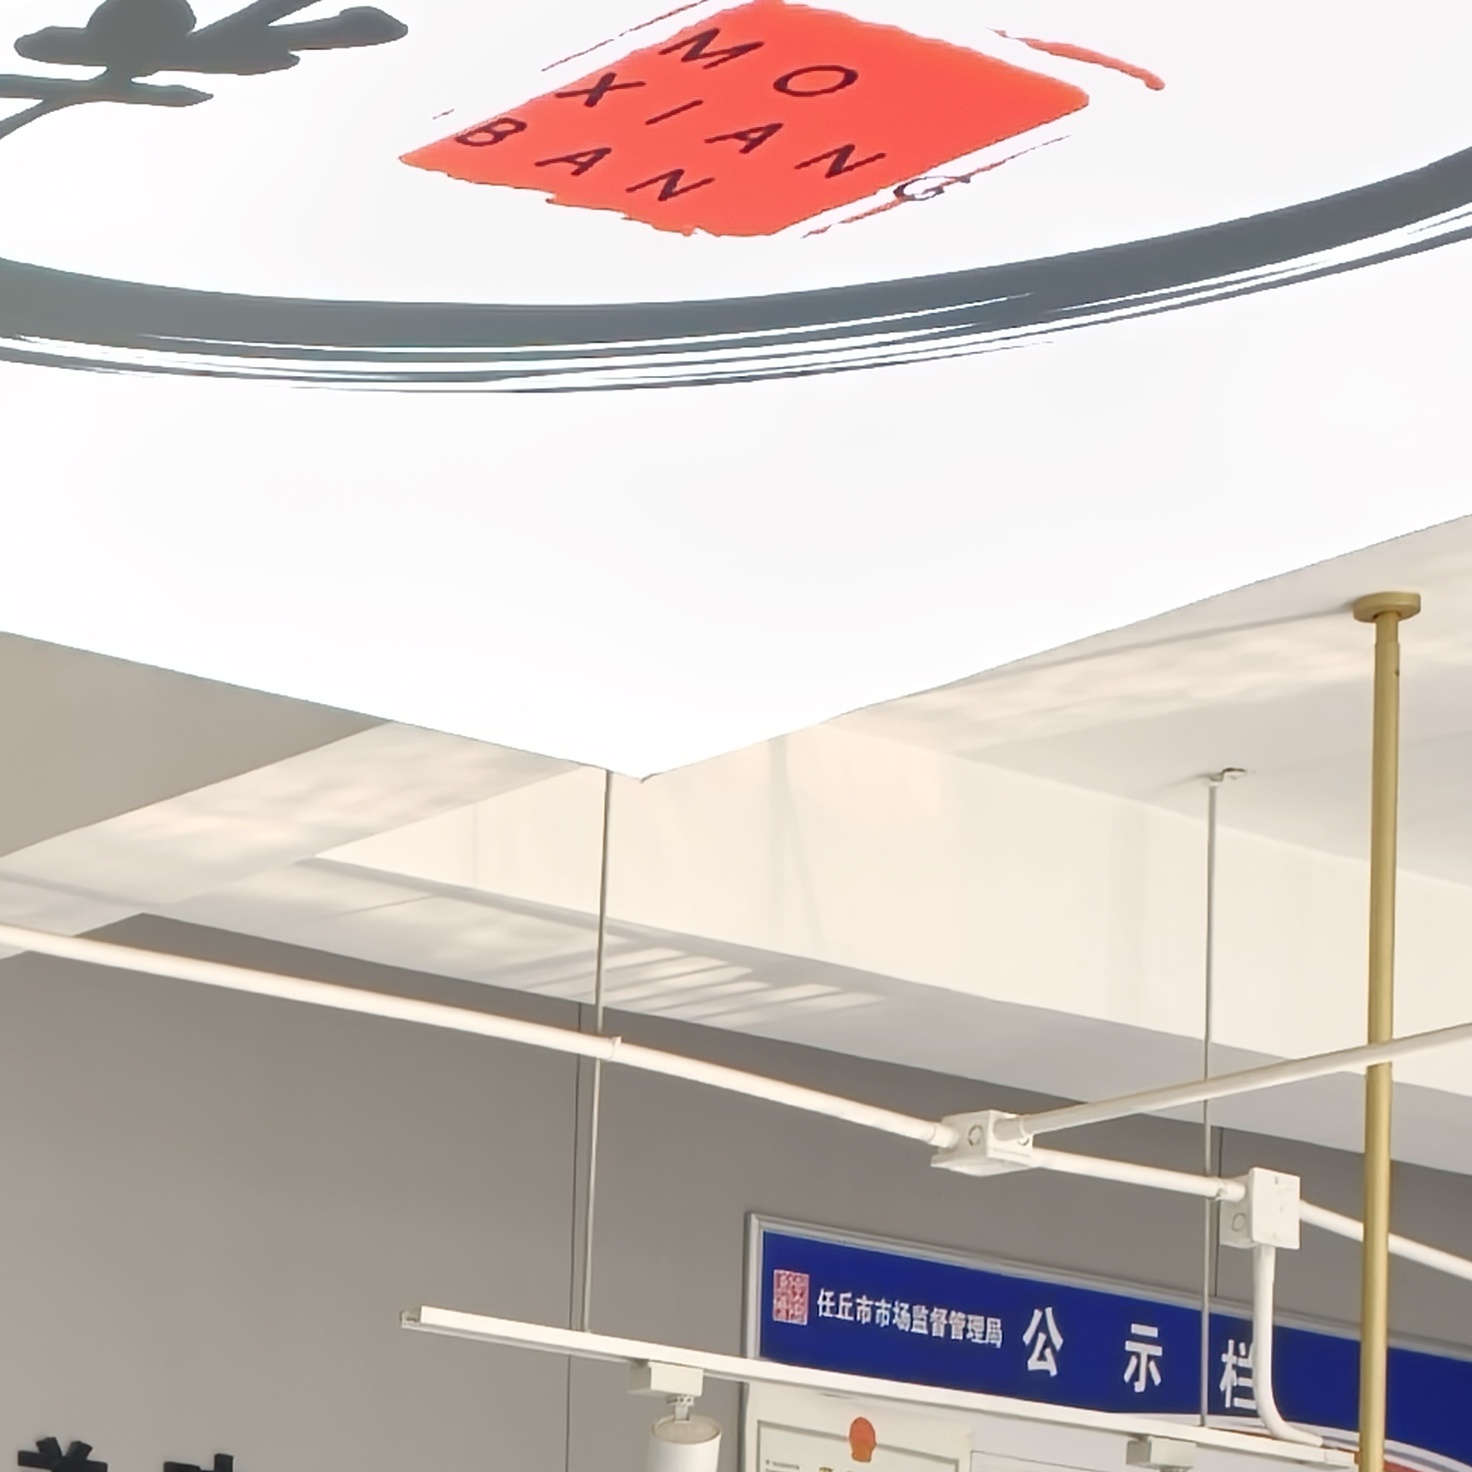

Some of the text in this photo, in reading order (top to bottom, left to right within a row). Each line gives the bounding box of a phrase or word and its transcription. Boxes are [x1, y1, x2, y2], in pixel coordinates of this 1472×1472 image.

[657, 27, 859, 98] MO
[454, 116, 716, 203] BAN
[817, 1288, 1003, 1348] 任丘市市场监督管理局
